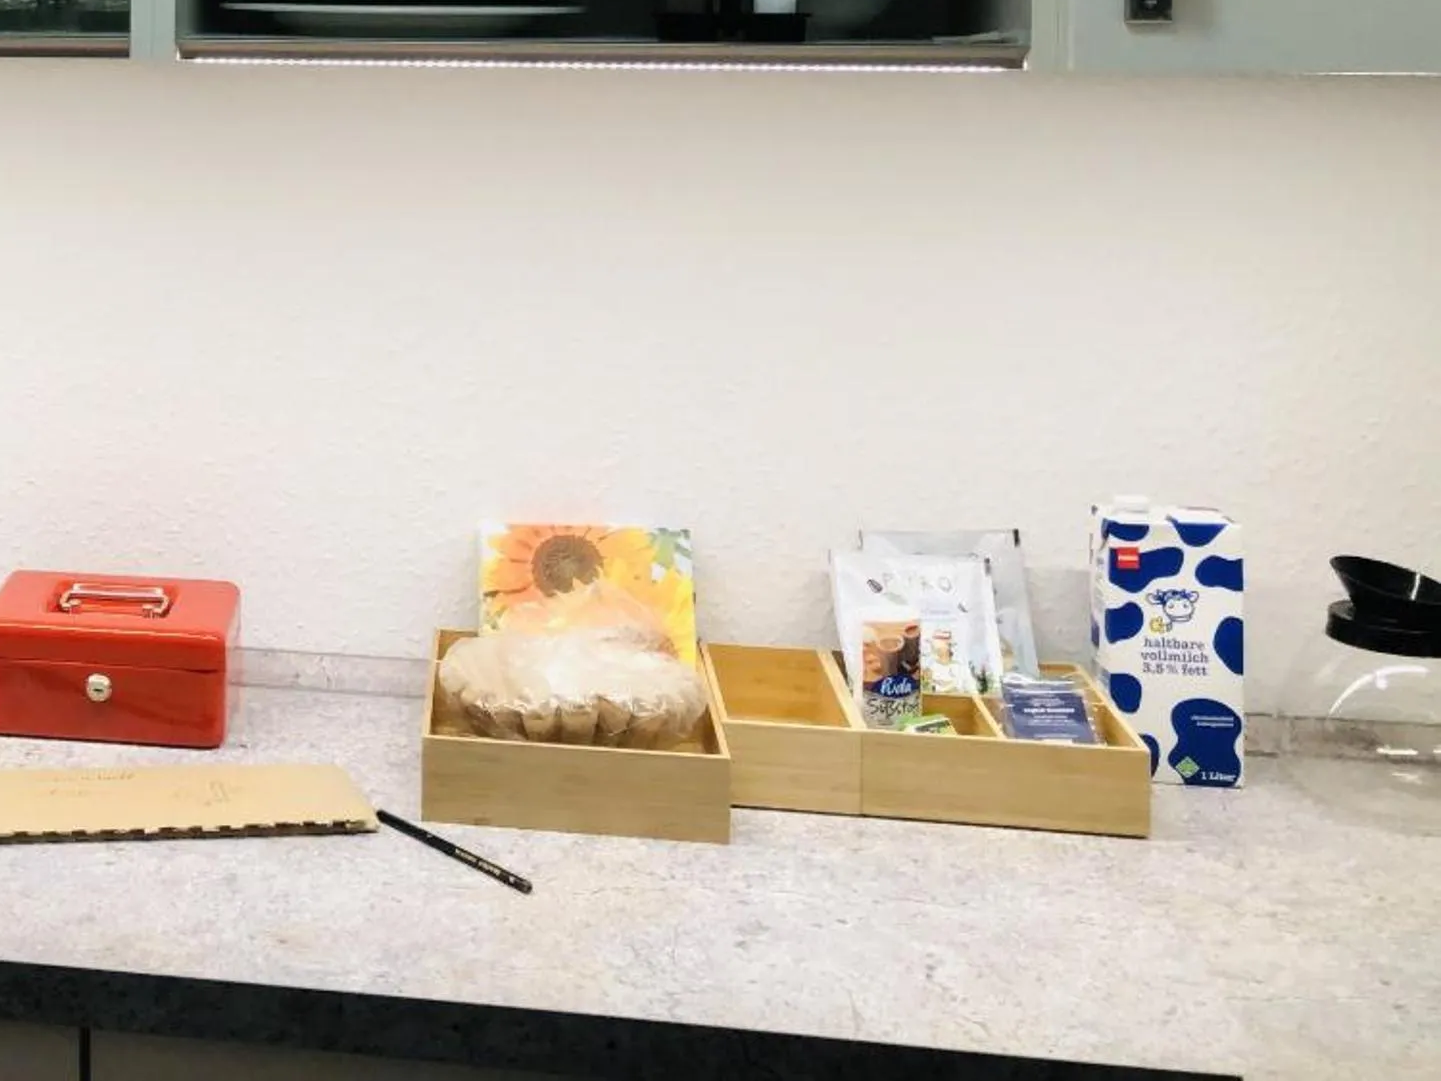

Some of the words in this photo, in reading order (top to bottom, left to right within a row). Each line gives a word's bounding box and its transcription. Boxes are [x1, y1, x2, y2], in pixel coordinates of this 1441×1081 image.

[1143, 636, 1206, 651] haltbare
[1140, 650, 1210, 664] vollmilch
[1181, 663, 1209, 677] fett
